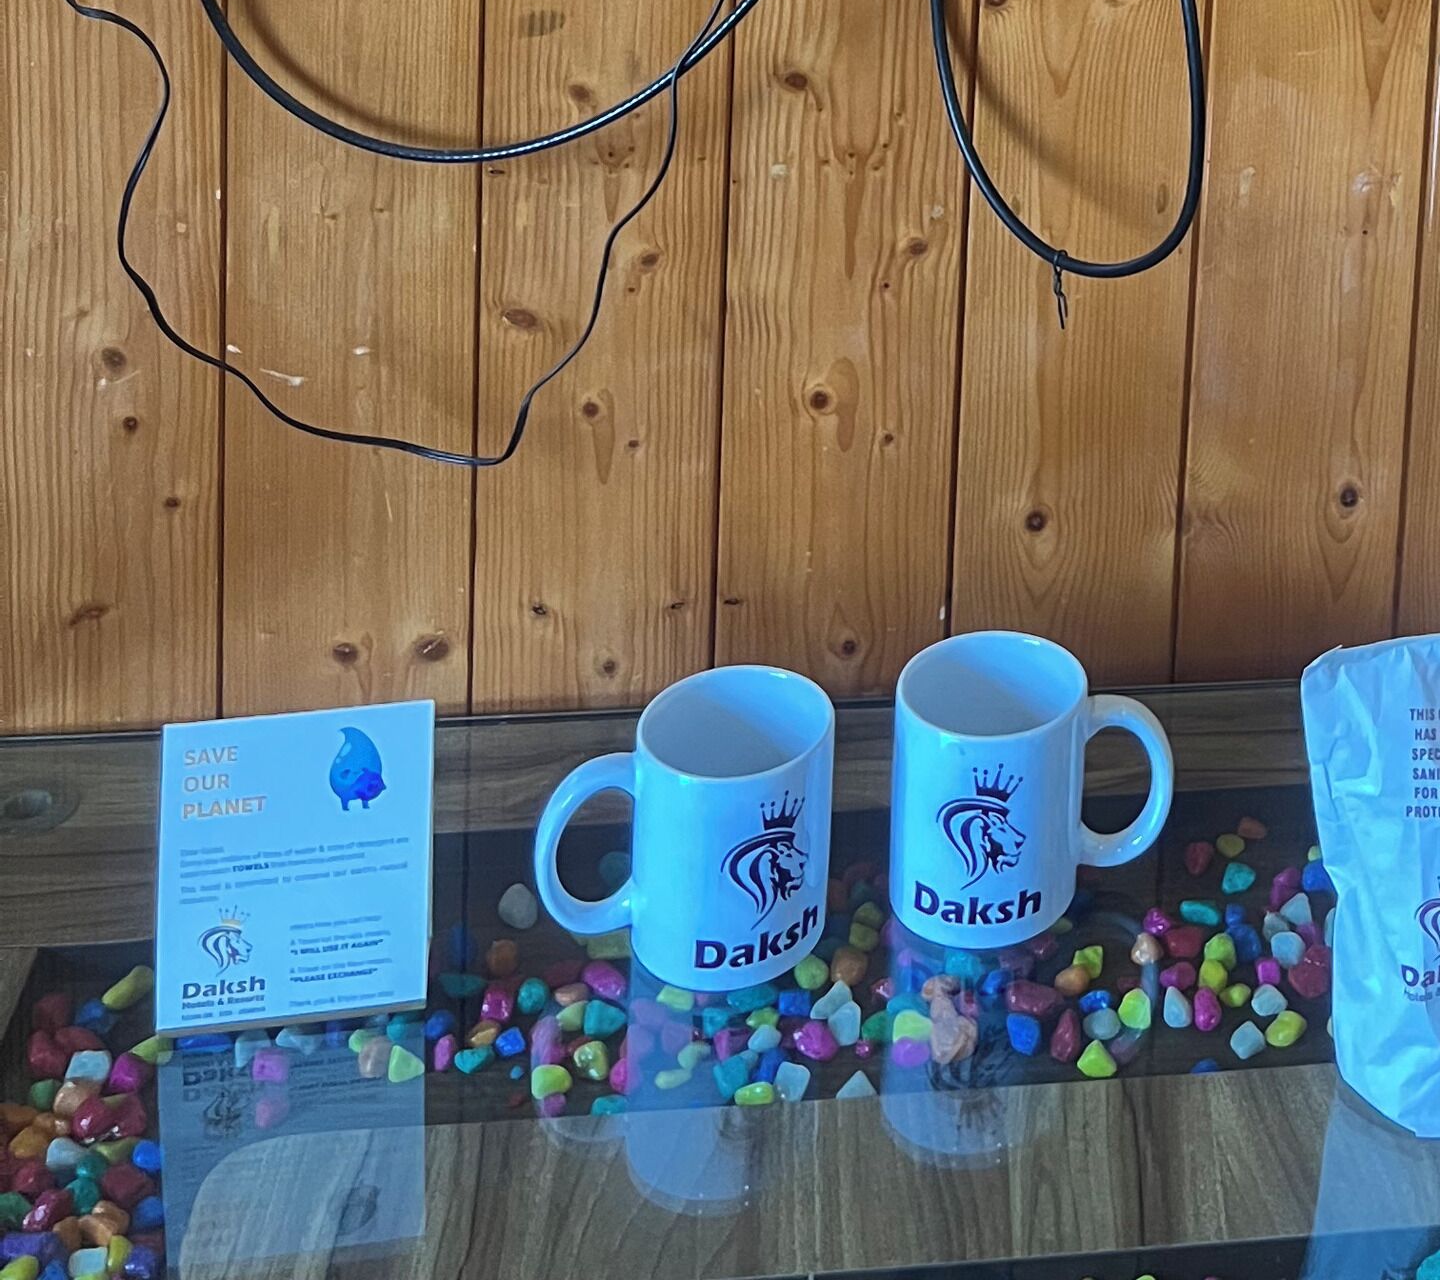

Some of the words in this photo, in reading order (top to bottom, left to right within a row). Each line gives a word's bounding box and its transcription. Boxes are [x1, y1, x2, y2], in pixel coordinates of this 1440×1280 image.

[1409, 708, 1436, 721] THIS
[1415, 728, 1437, 740] HAS
[184, 745, 239, 766] SAVE
[184, 773, 230, 793] OUR
[1414, 787, 1438, 799] FOR
[183, 795, 267, 819] PLANET
[914, 880, 1042, 926] Daksh
[694, 903, 819, 970] Daksh
[182, 975, 266, 1000] Daksh
